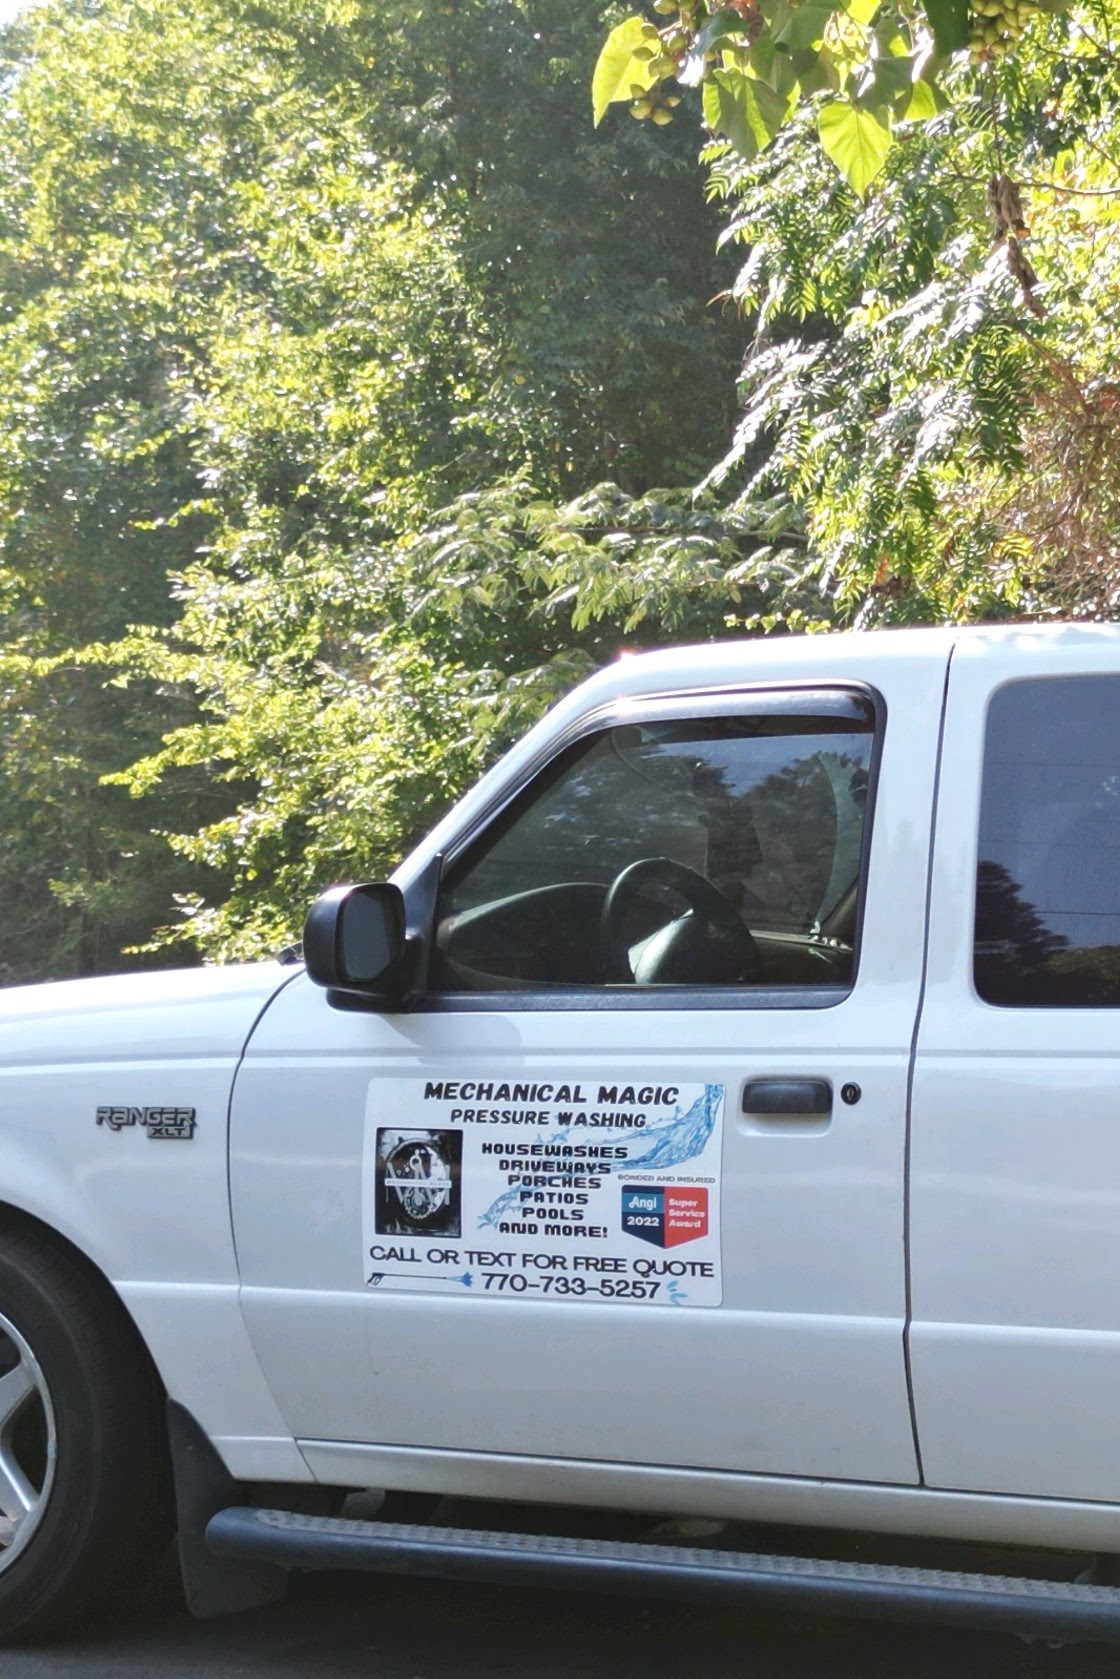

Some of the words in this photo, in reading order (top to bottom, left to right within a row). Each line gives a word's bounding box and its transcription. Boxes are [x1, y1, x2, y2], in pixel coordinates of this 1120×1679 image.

[424, 1082, 587, 1103] MECHANICAL
[597, 1085, 679, 1105] MAGIC
[96, 1106, 197, 1131] RANGER
[450, 1109, 550, 1125] PRESSURE
[558, 1111, 646, 1128] WASHING
[151, 1127, 186, 1136] XLT
[482, 1142, 628, 1159] HOUSEWASHES
[499, 1159, 611, 1174] DRIVEWAYS
[508, 1175, 602, 1189] PORCHES
[519, 1191, 589, 1205] PATIOS
[668, 1198, 698, 1208] Super
[522, 1207, 584, 1221] POOLS
[668, 1209, 705, 1218] Service
[627, 1216, 660, 1227] 2022
[668, 1220, 701, 1228] Award
[499, 1222, 538, 1235] AND
[544, 1224, 608, 1238] MORE!
[369, 1245, 422, 1263] CALL
[426, 1248, 460, 1265] OR
[464, 1250, 517, 1267] TEXT
[522, 1253, 568, 1270] FOR
[573, 1256, 627, 1273] FREE
[632, 1258, 714, 1278] QUOTE
[481, 1272, 661, 1299] 770-733-5257
